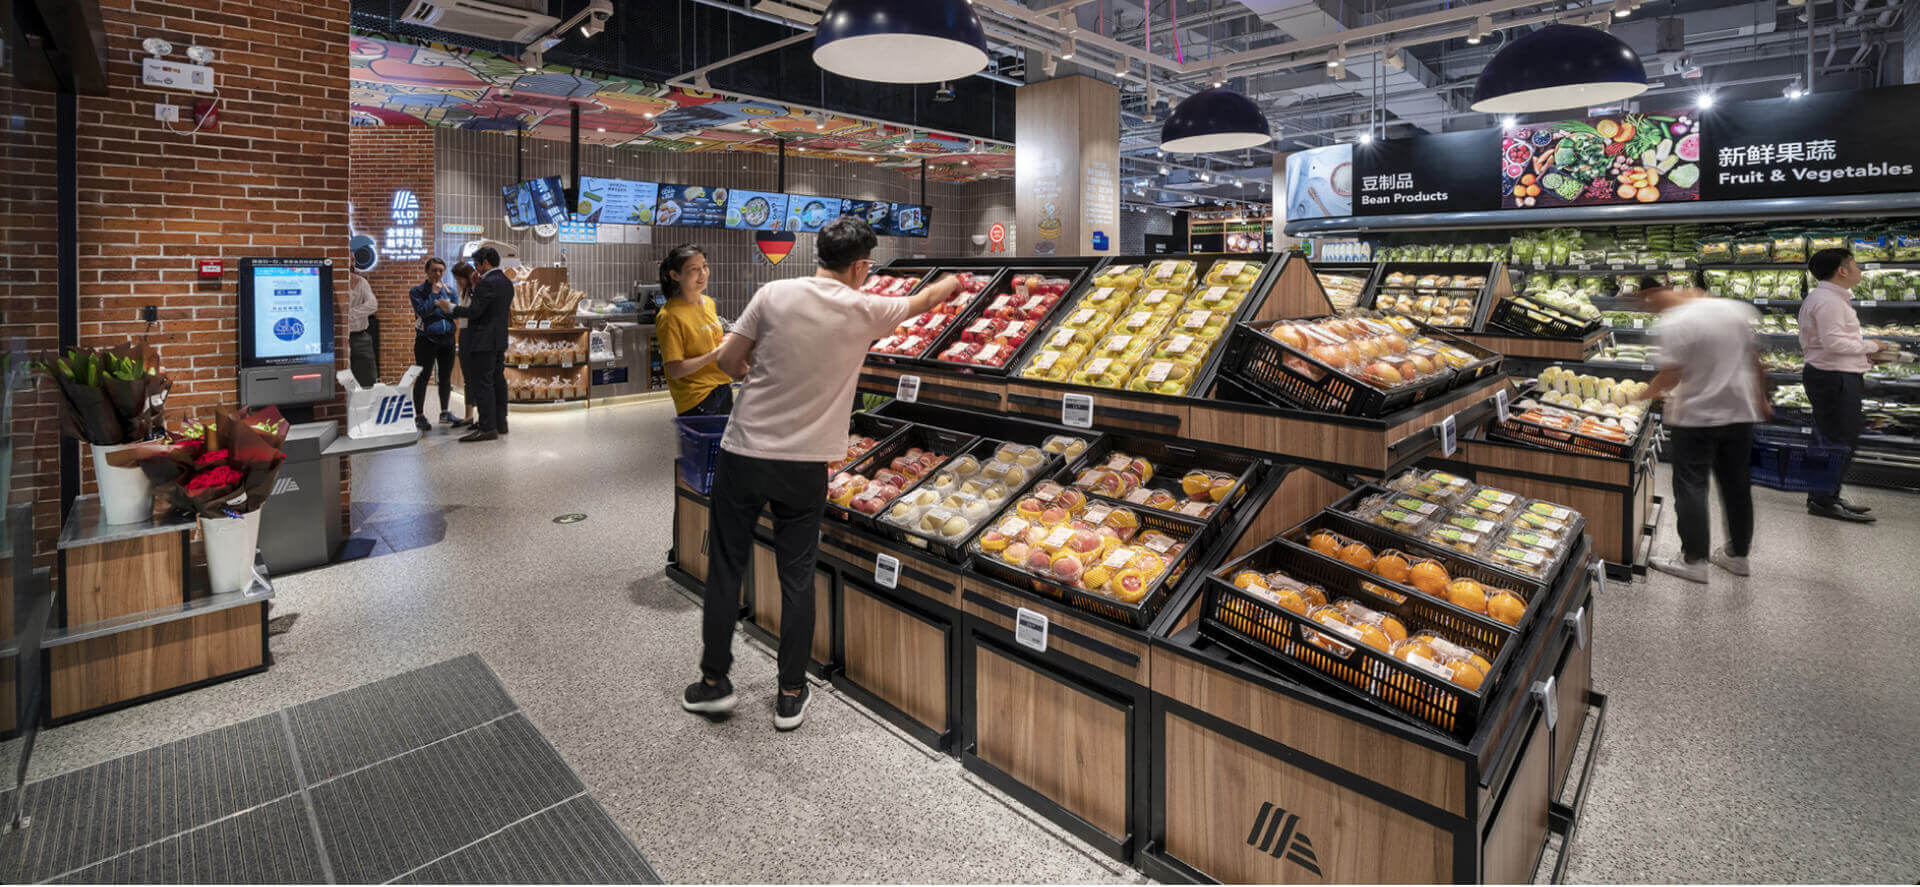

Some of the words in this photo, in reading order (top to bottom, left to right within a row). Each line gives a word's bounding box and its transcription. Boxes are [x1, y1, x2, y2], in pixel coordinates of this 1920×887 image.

[1718, 139, 1837, 168] 新鲜果蔬
[1361, 172, 1414, 192] 豆制品
[1718, 171, 1765, 185] Fruit
[1770, 169, 1786, 182] &
[1792, 162, 1913, 183] Vegetables
[1361, 195, 1390, 205] Bean
[1394, 191, 1449, 203] Products
[392, 210, 419, 219] ALDI
